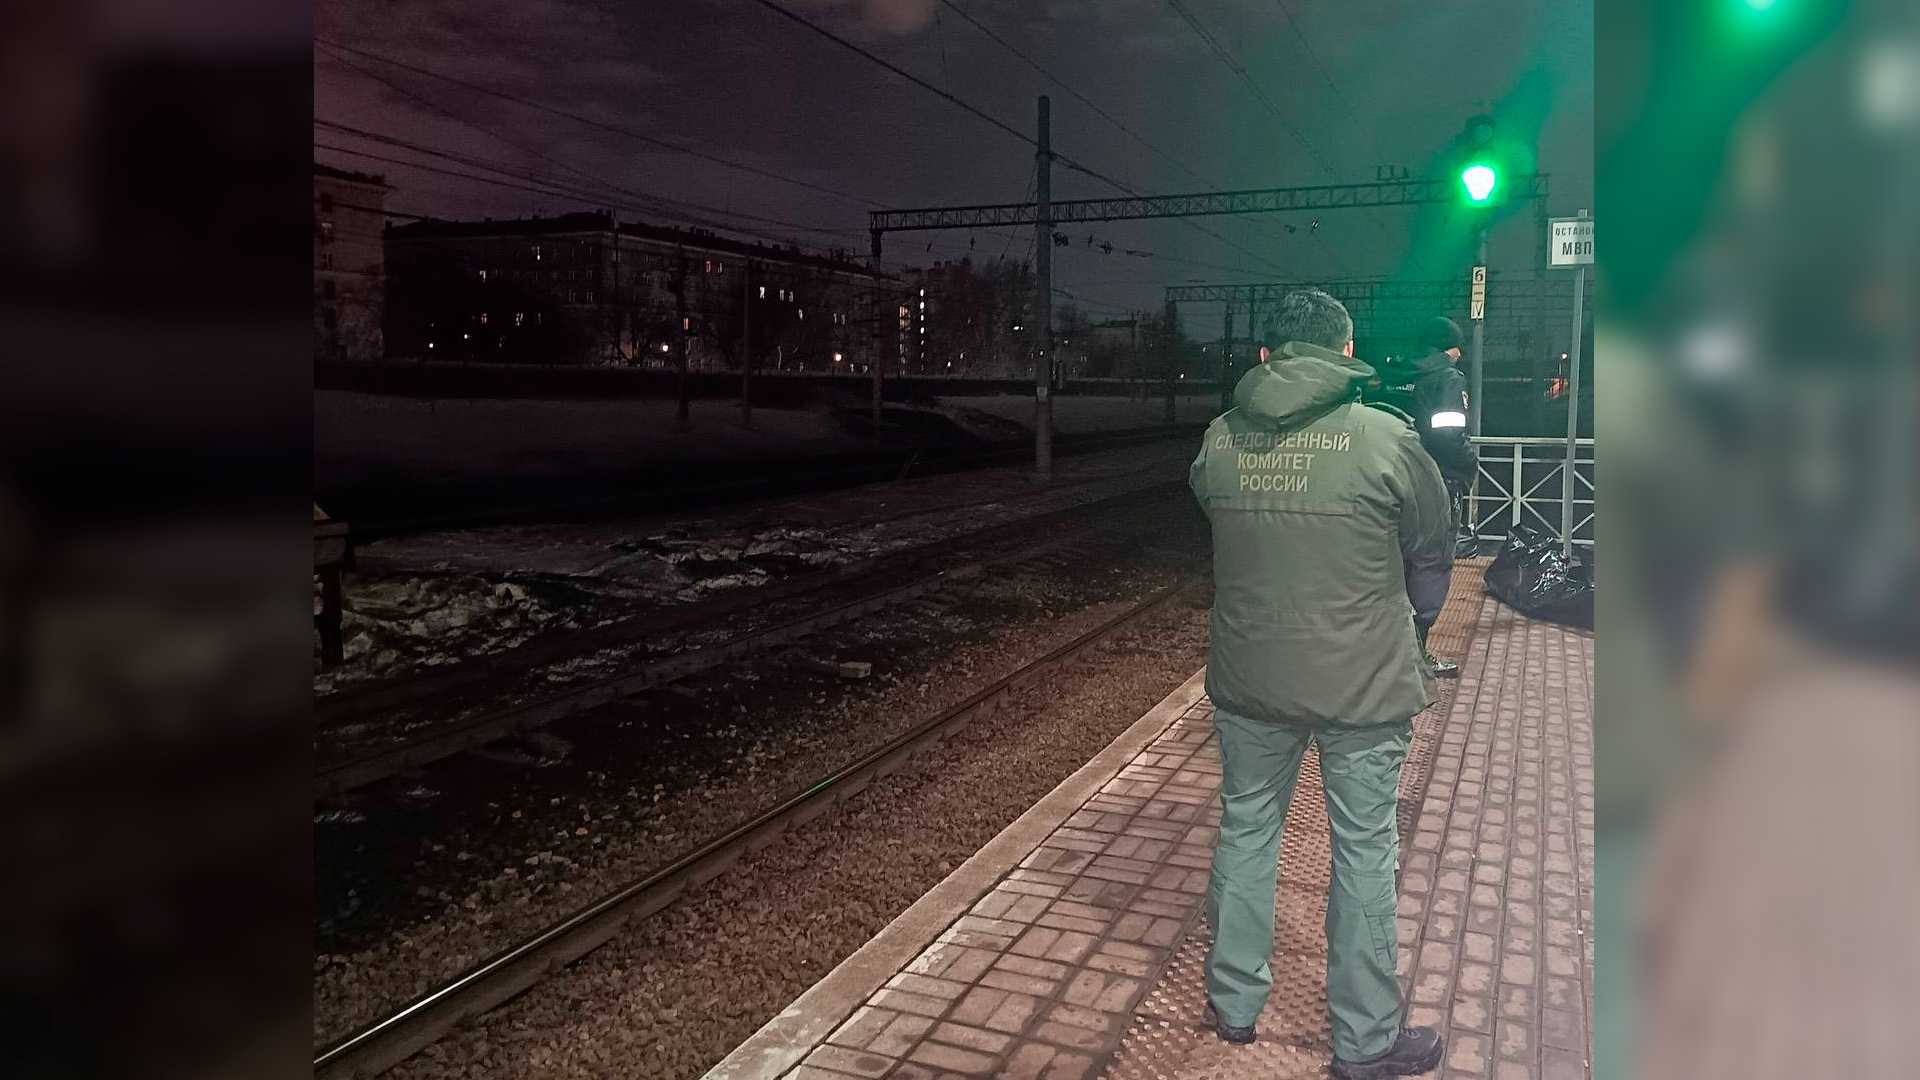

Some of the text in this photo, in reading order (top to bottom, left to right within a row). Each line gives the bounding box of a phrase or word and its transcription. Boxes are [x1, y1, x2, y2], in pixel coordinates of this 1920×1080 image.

[1215, 431, 1350, 451] СЛЕДСТВЕННЫЙ
[1237, 453, 1315, 470] КОМИТЕТ
[1240, 475, 1308, 492] РОССИИ
